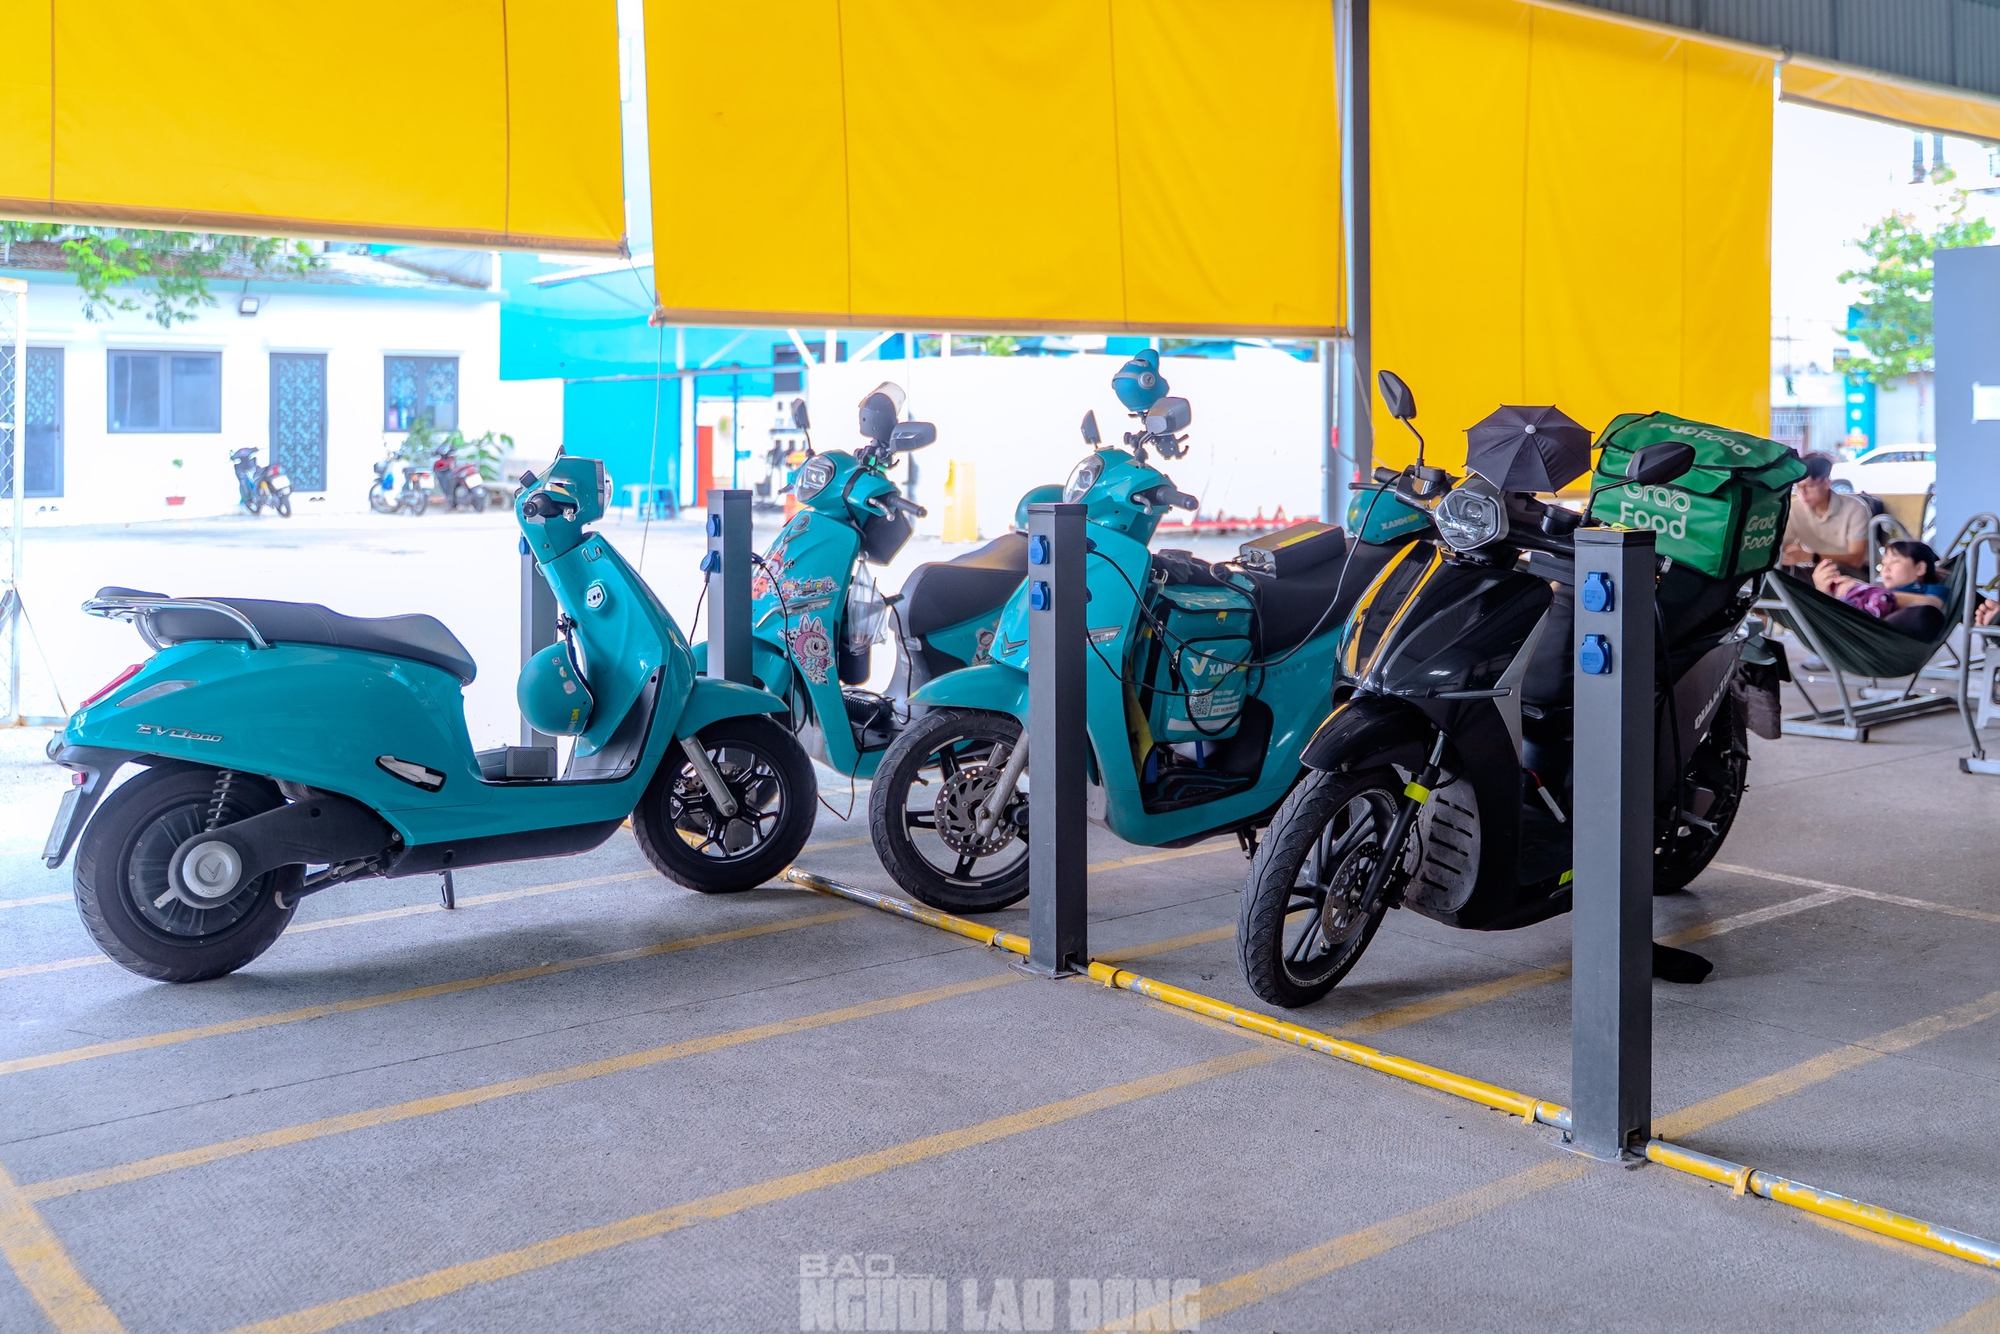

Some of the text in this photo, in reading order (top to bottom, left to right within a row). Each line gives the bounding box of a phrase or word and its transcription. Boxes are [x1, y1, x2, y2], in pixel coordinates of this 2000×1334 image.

[1694, 429, 1752, 456] Food
[1619, 501, 1687, 540] Food
[1746, 511, 1777, 533] Grab
[1741, 528, 1777, 552] Food
